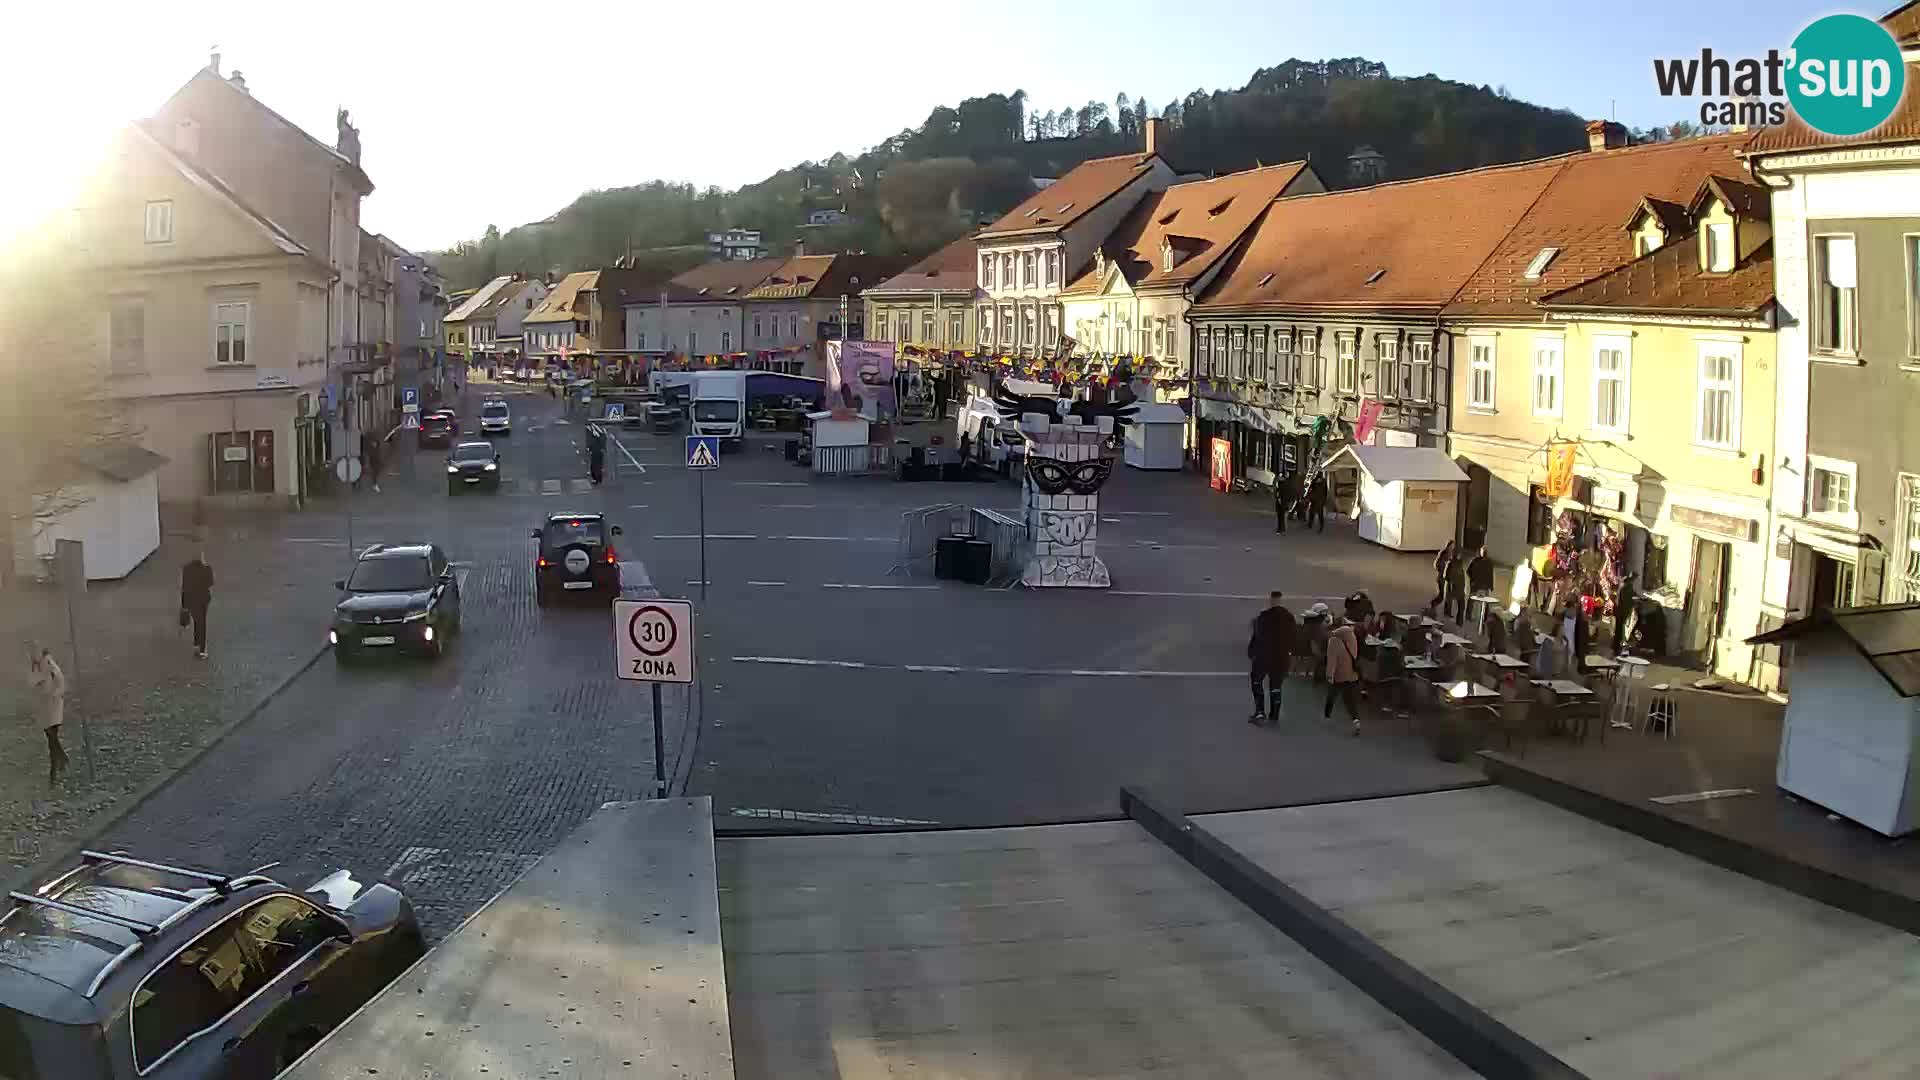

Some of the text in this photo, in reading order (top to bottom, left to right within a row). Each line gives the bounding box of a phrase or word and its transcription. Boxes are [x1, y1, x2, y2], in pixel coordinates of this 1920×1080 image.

[1047, 515, 1086, 545] 200
[641, 621, 666, 643] 30
[632, 659, 676, 676] ZONA
